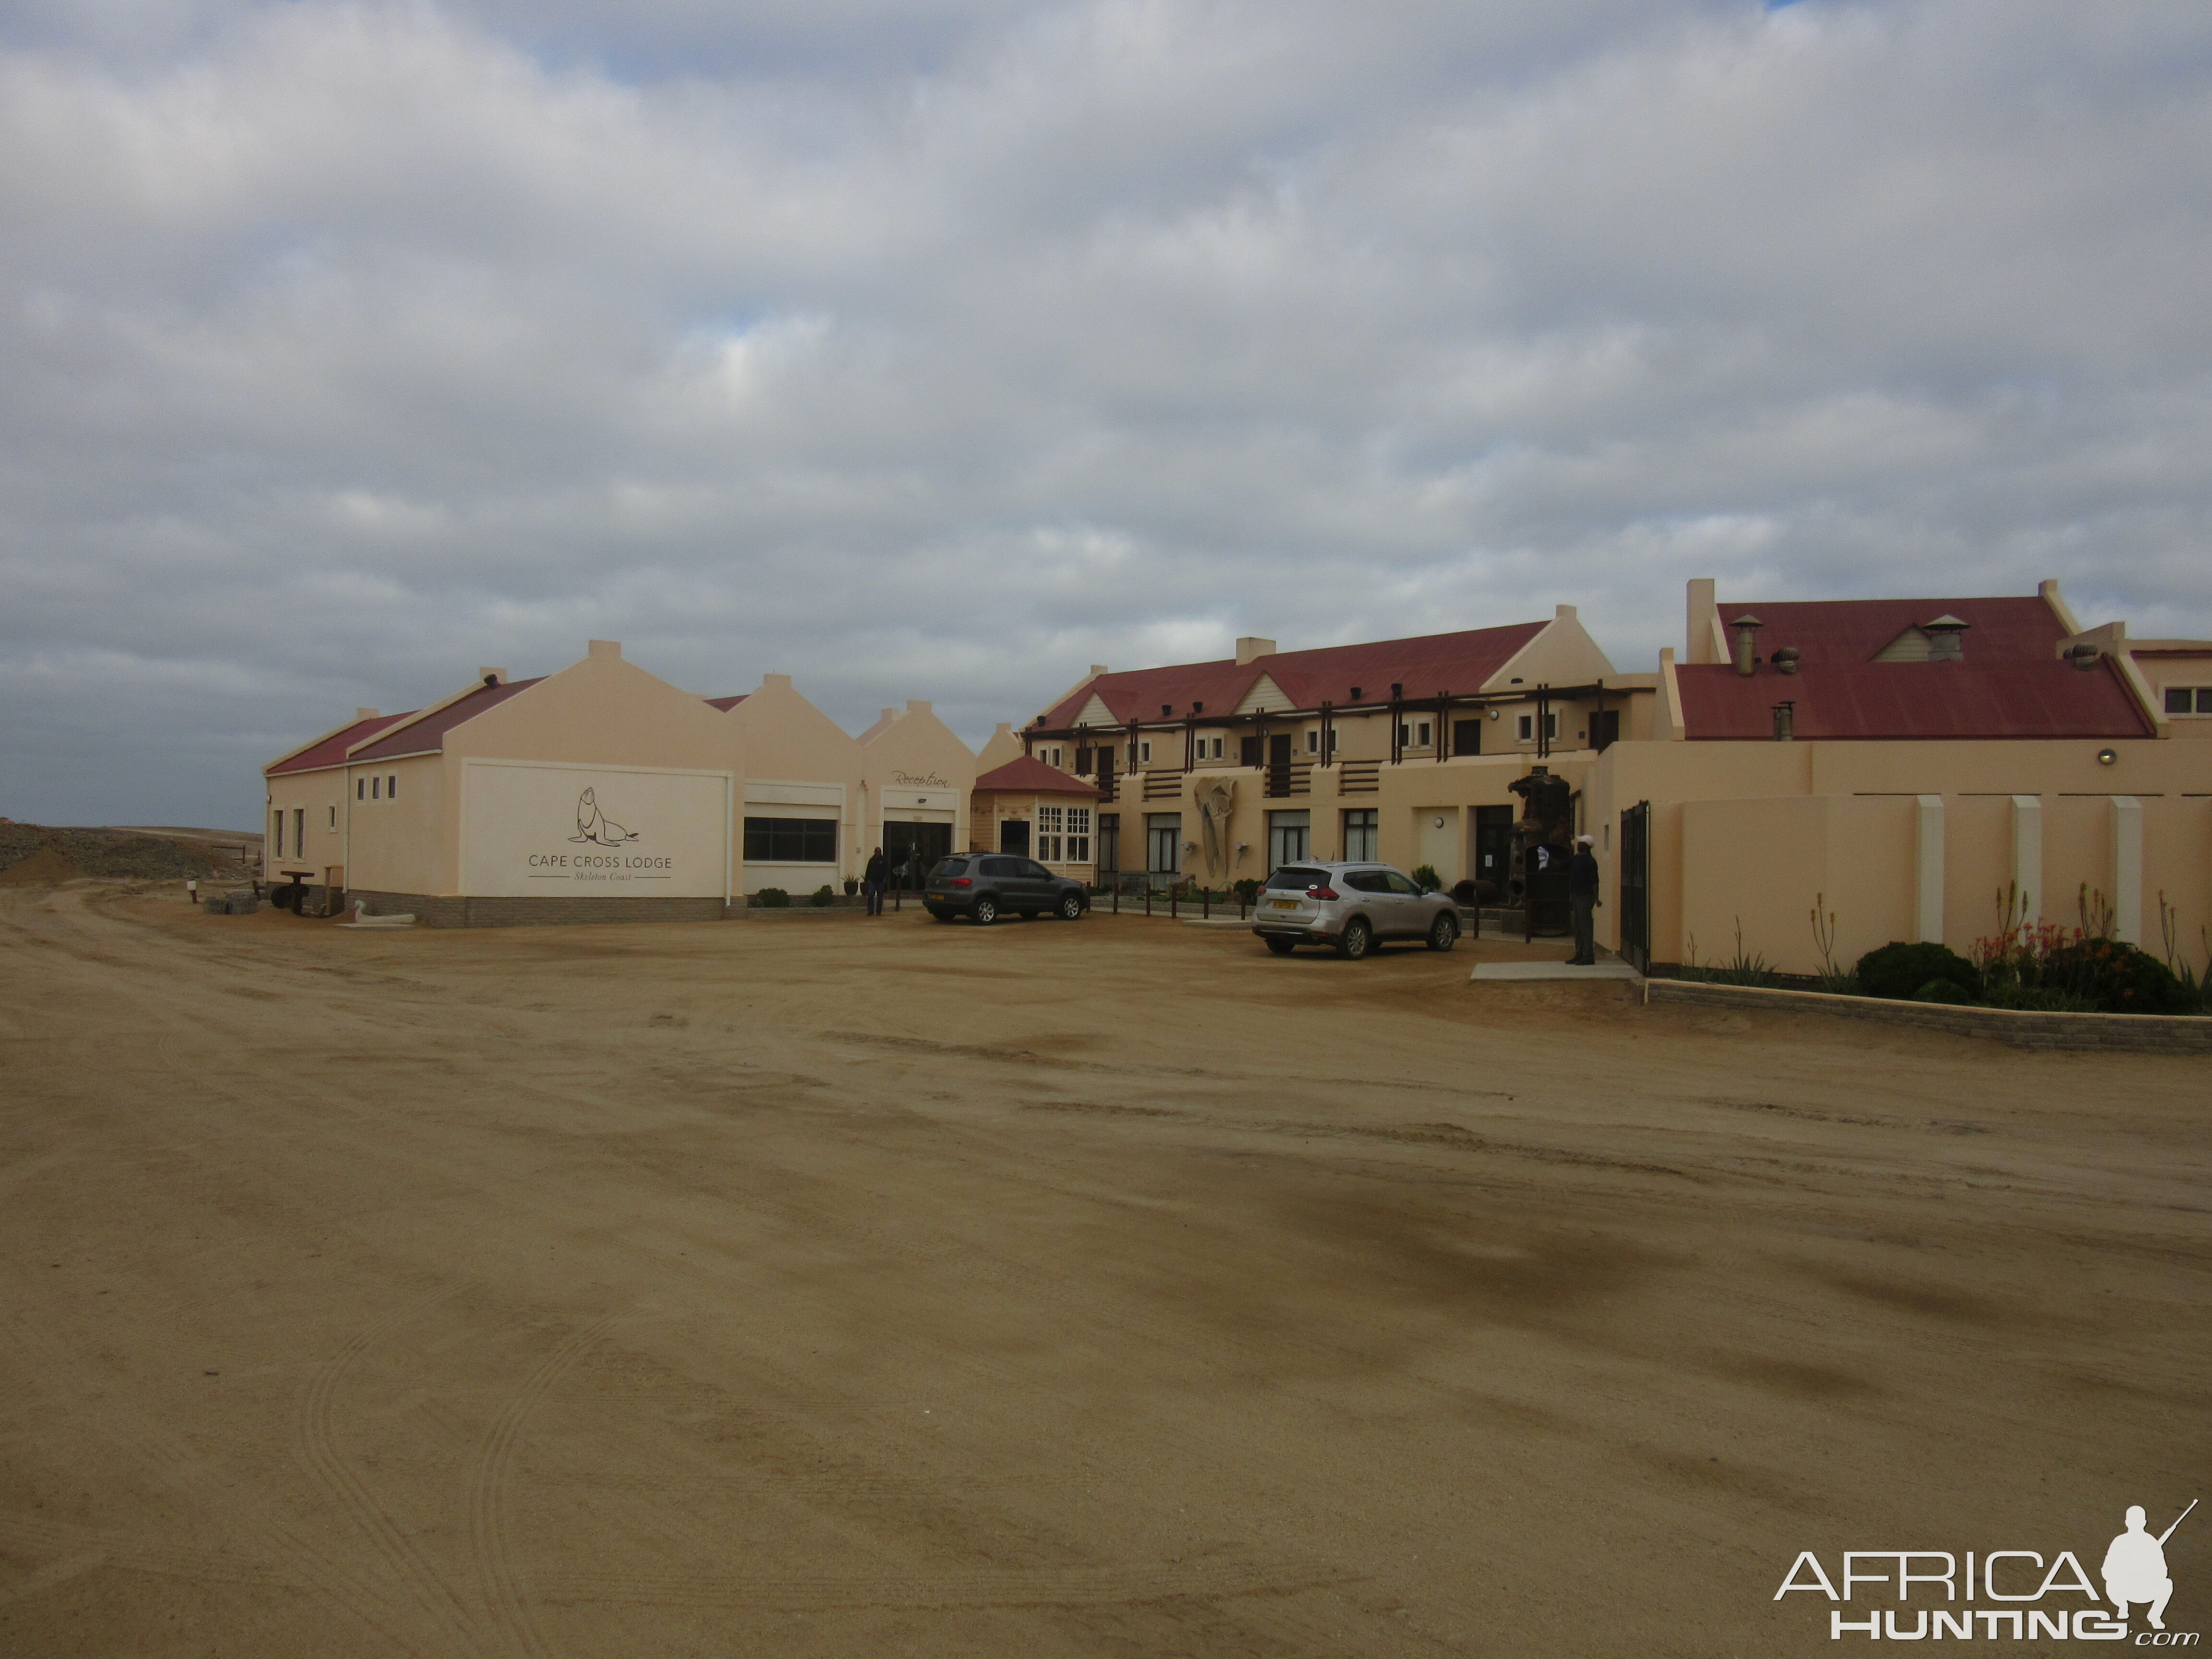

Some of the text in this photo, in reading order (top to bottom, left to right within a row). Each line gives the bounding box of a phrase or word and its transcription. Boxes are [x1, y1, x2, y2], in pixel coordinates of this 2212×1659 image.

[891, 770, 950, 789] Reception
[529, 855, 671, 868] CAPE CROSS LODGE
[575, 872, 631, 880] Skeleton Coast
